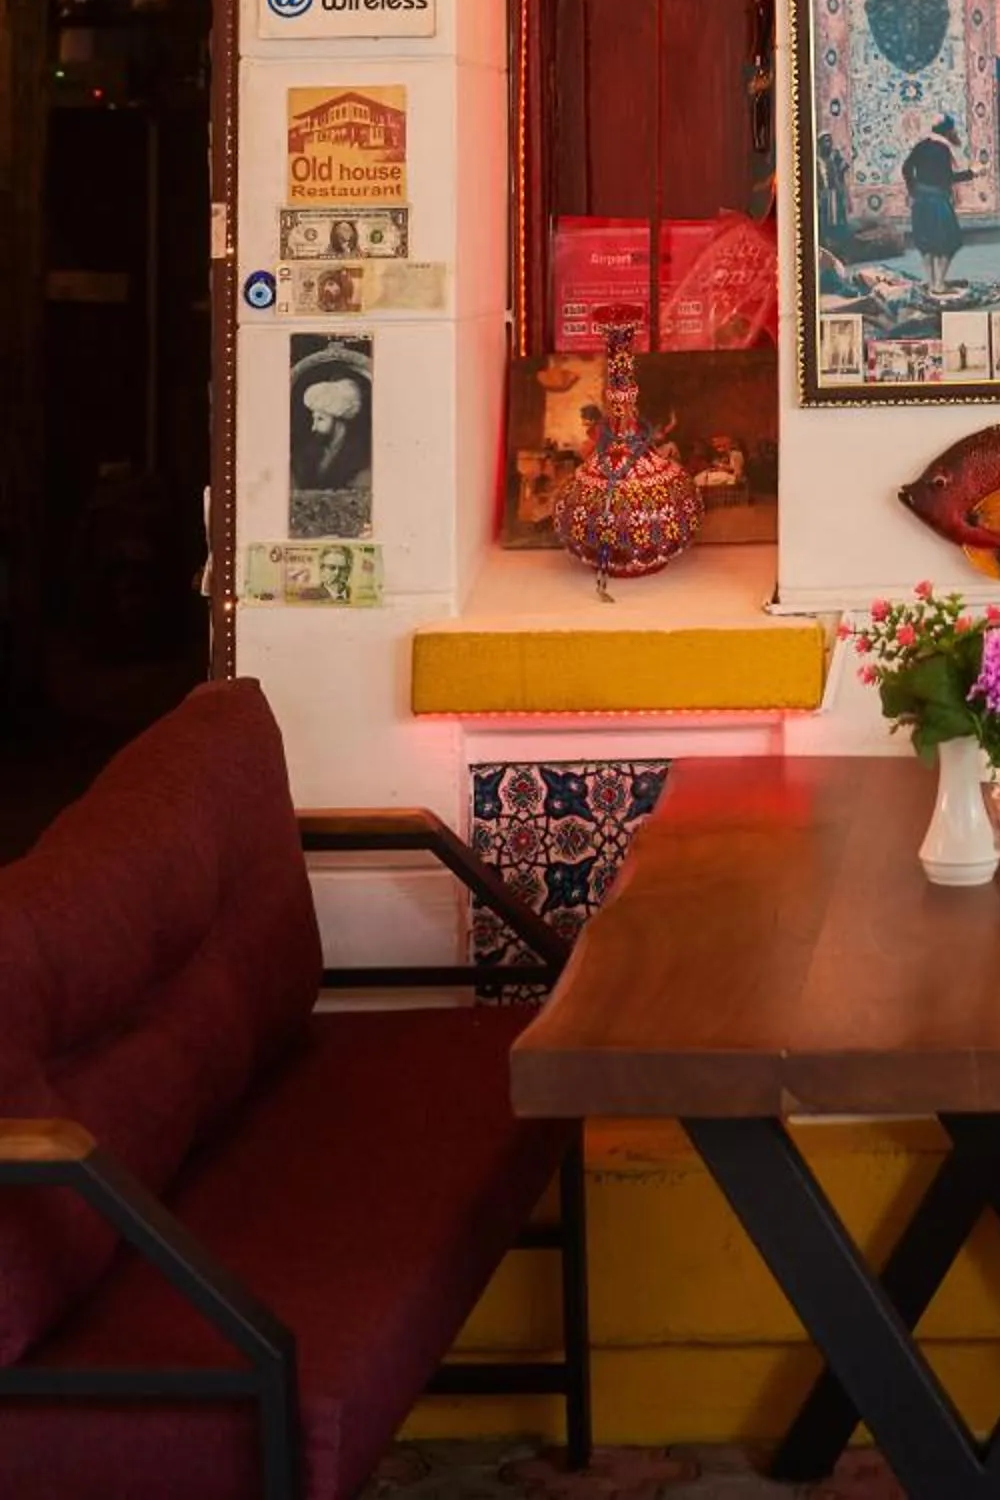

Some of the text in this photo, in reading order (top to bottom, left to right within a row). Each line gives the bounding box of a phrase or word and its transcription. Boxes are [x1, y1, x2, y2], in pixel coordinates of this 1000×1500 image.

[291, 156, 402, 182] Old house
[291, 184, 402, 198] Restaurant
